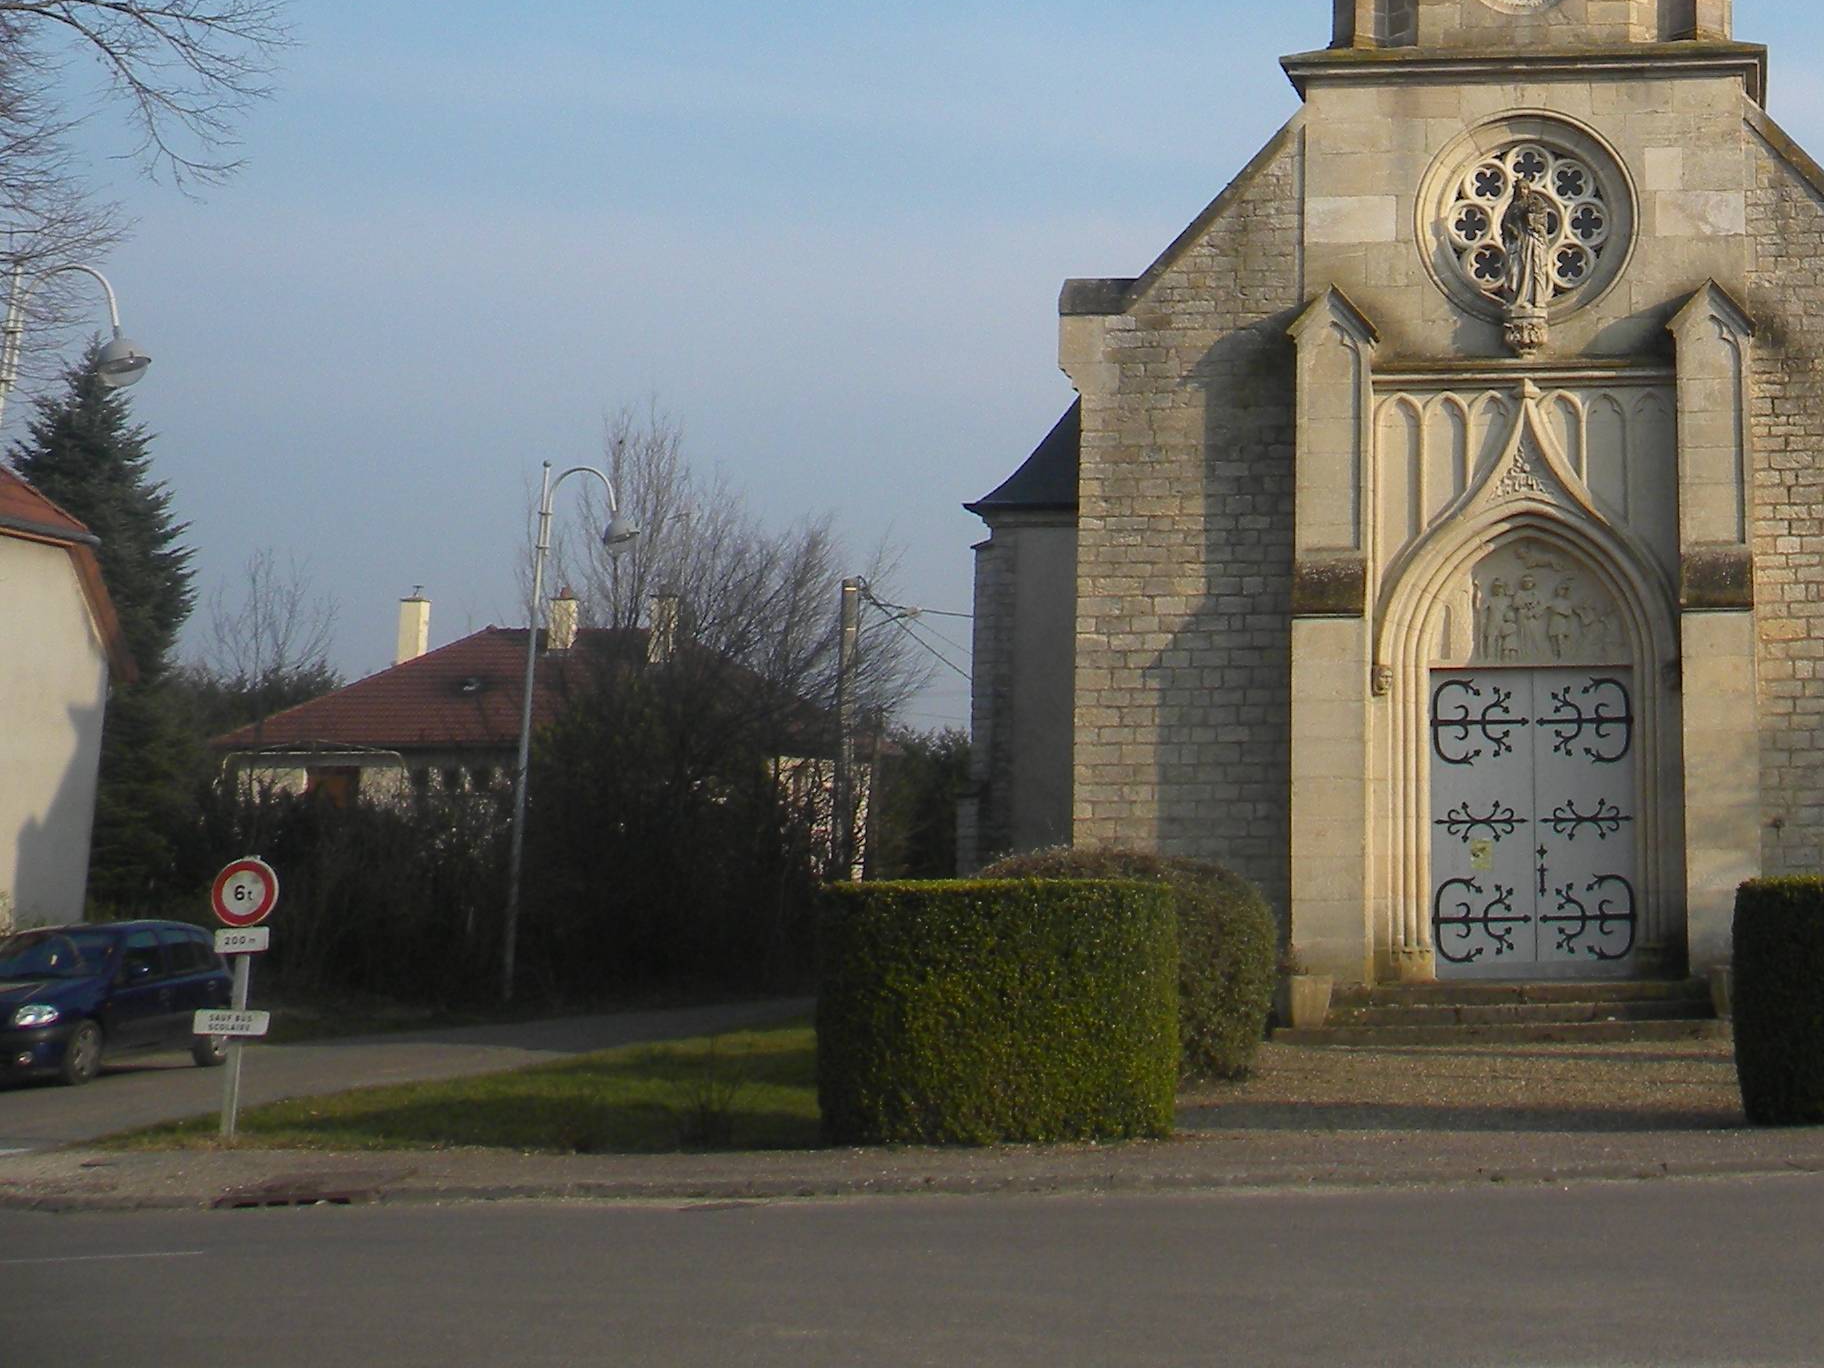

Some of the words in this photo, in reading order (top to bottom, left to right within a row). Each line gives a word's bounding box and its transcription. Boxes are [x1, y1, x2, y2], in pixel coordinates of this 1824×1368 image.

[224, 935, 247, 946] 200
[208, 1014, 232, 1023] SAUF
[235, 1014, 253, 1024] BUS
